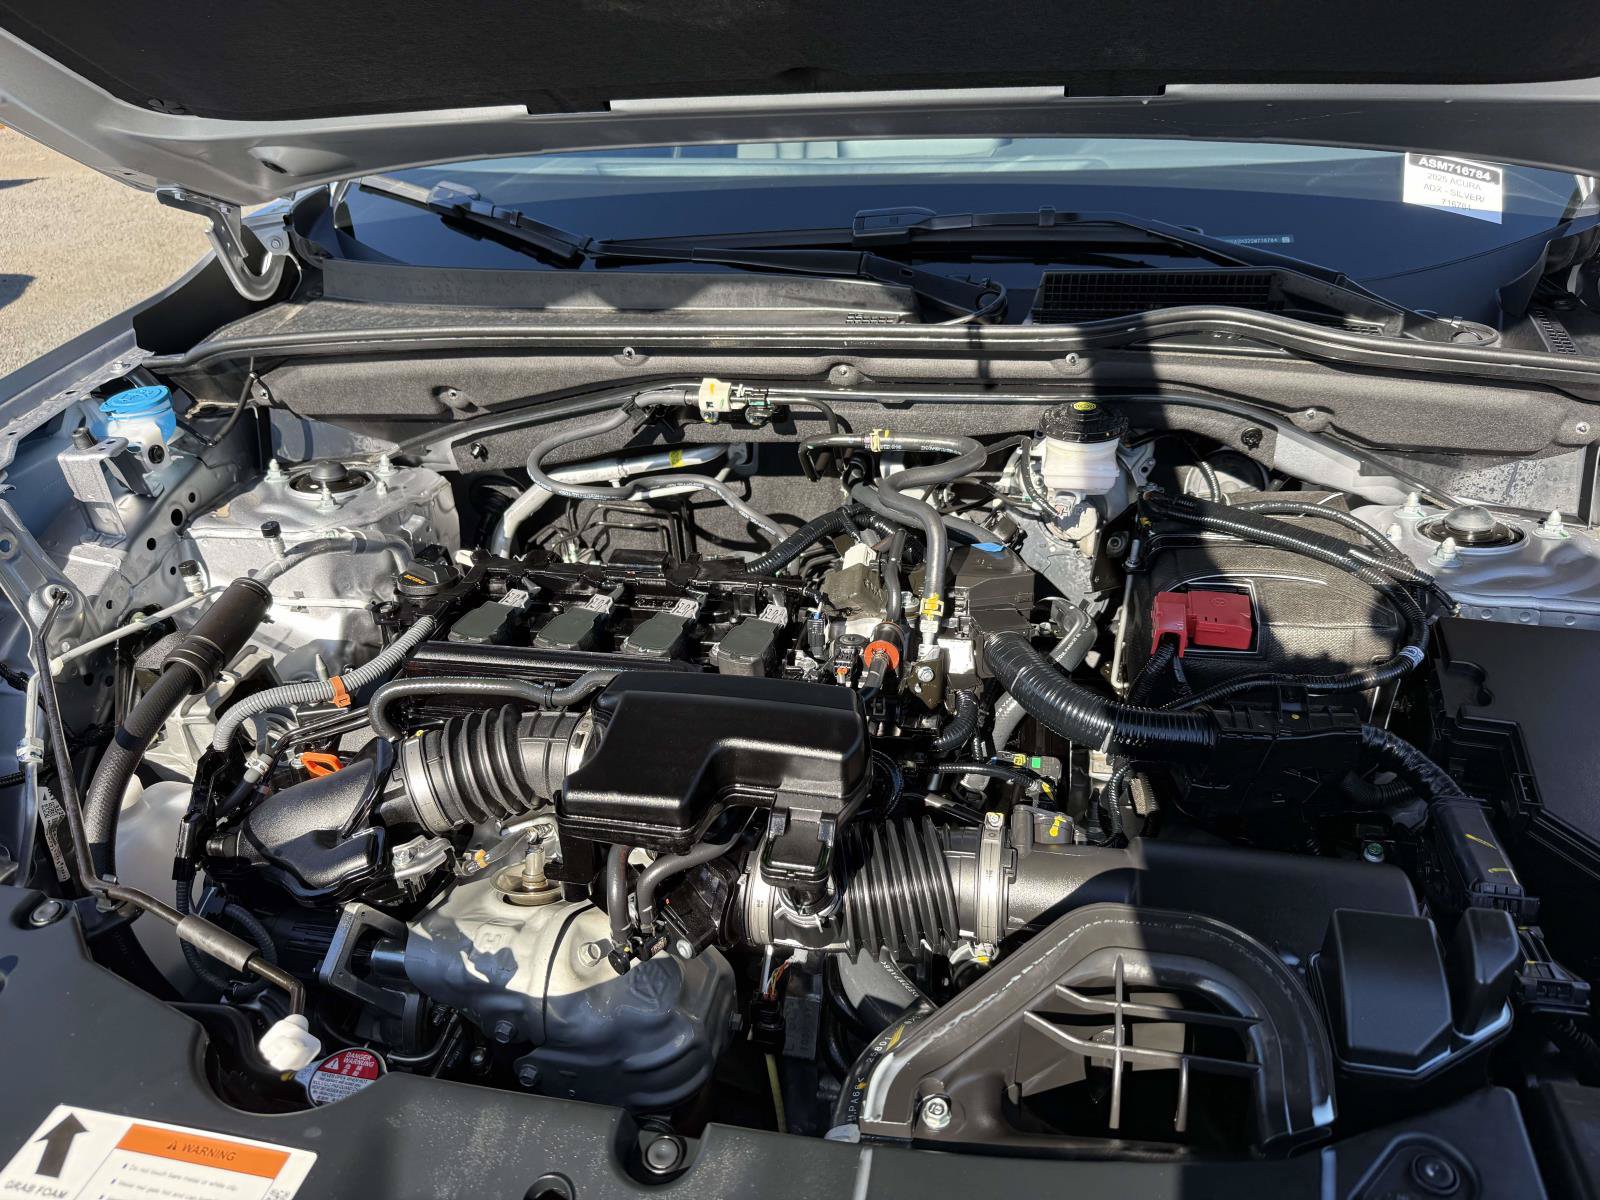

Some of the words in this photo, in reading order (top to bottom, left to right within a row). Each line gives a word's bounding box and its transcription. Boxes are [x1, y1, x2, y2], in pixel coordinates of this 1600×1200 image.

[1418, 157, 1492, 181] ASM716784
[1423, 183, 1442, 193] ADX
[1449, 176, 1482, 191] ACURA
[182, 1143, 237, 1161] WARNING
